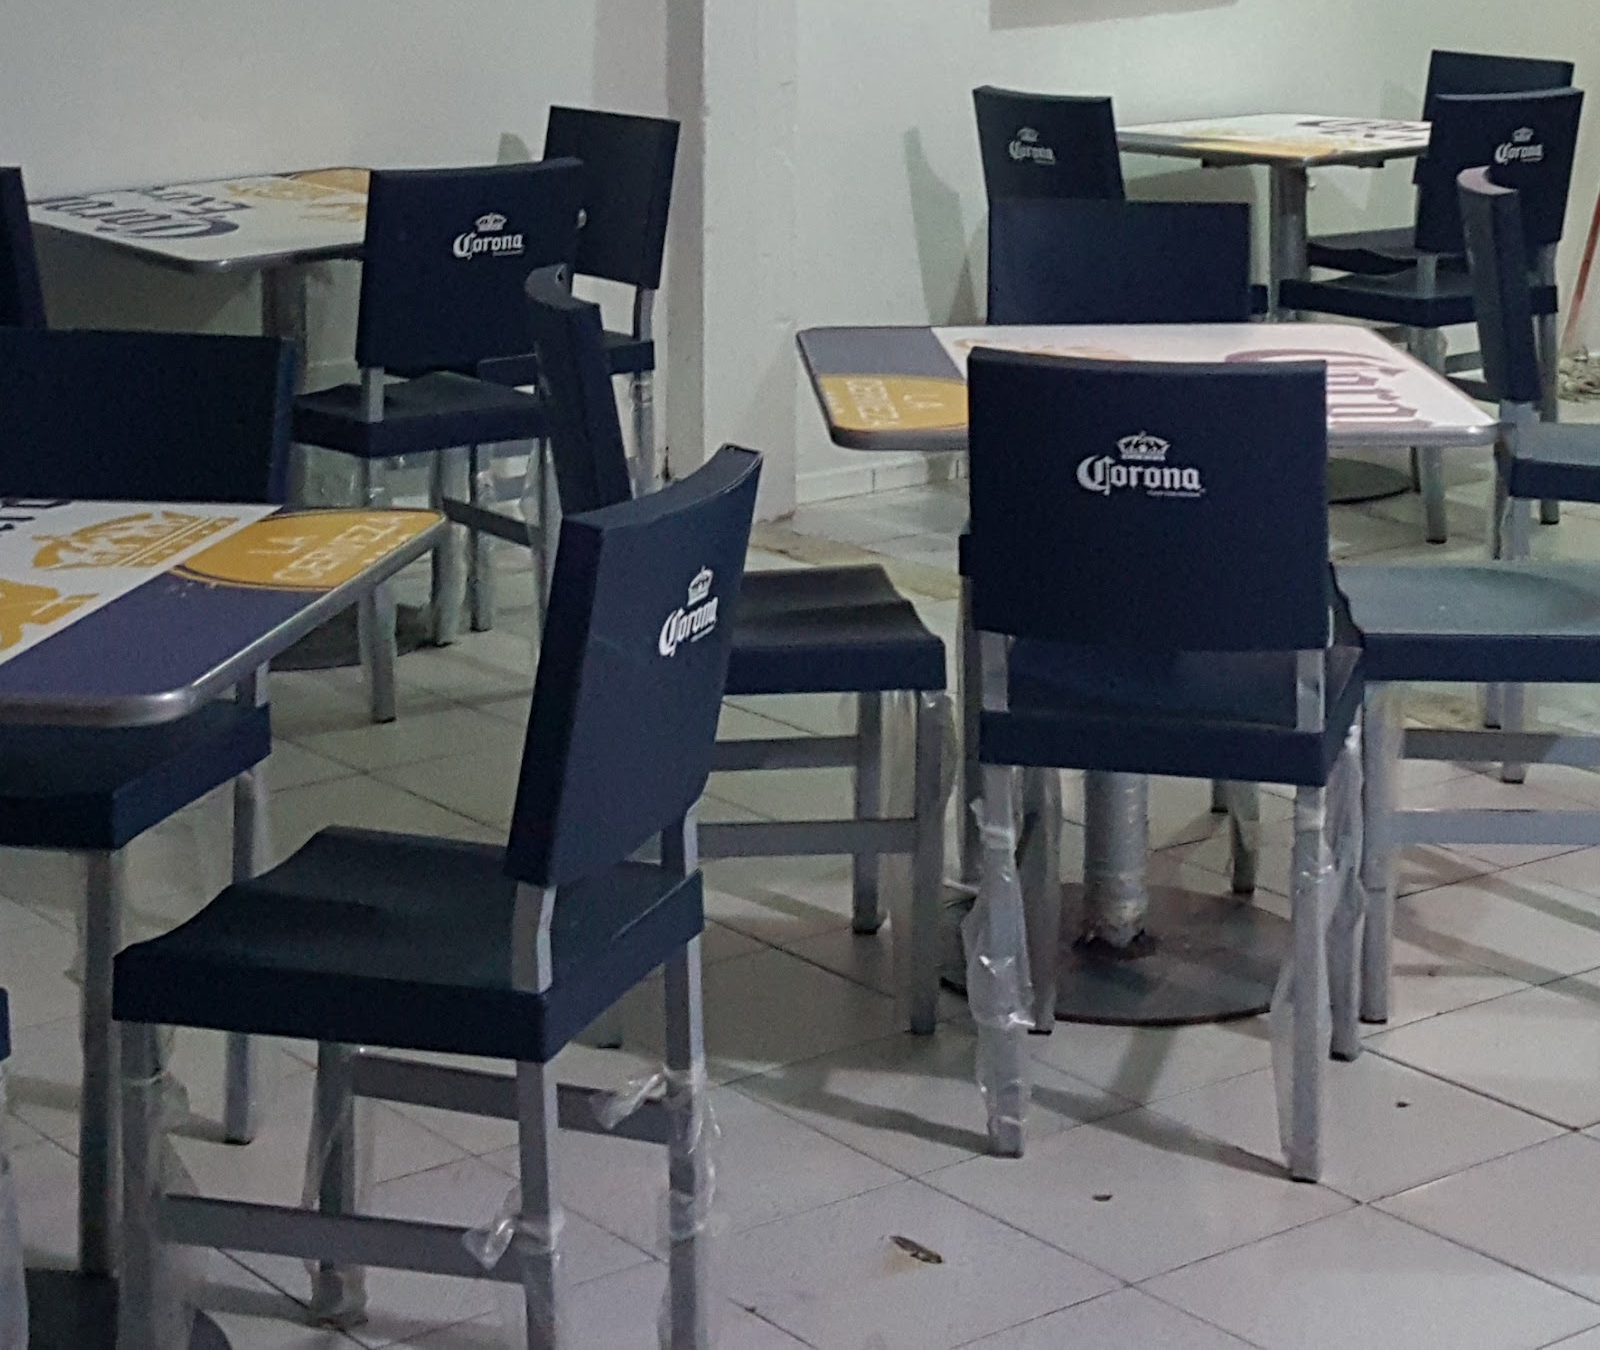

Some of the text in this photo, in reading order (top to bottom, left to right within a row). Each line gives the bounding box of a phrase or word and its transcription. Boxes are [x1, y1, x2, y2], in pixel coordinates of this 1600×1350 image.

[453, 232, 524, 260] Corona
[1076, 454, 1201, 496] Corona
[659, 596, 719, 658] Corona
